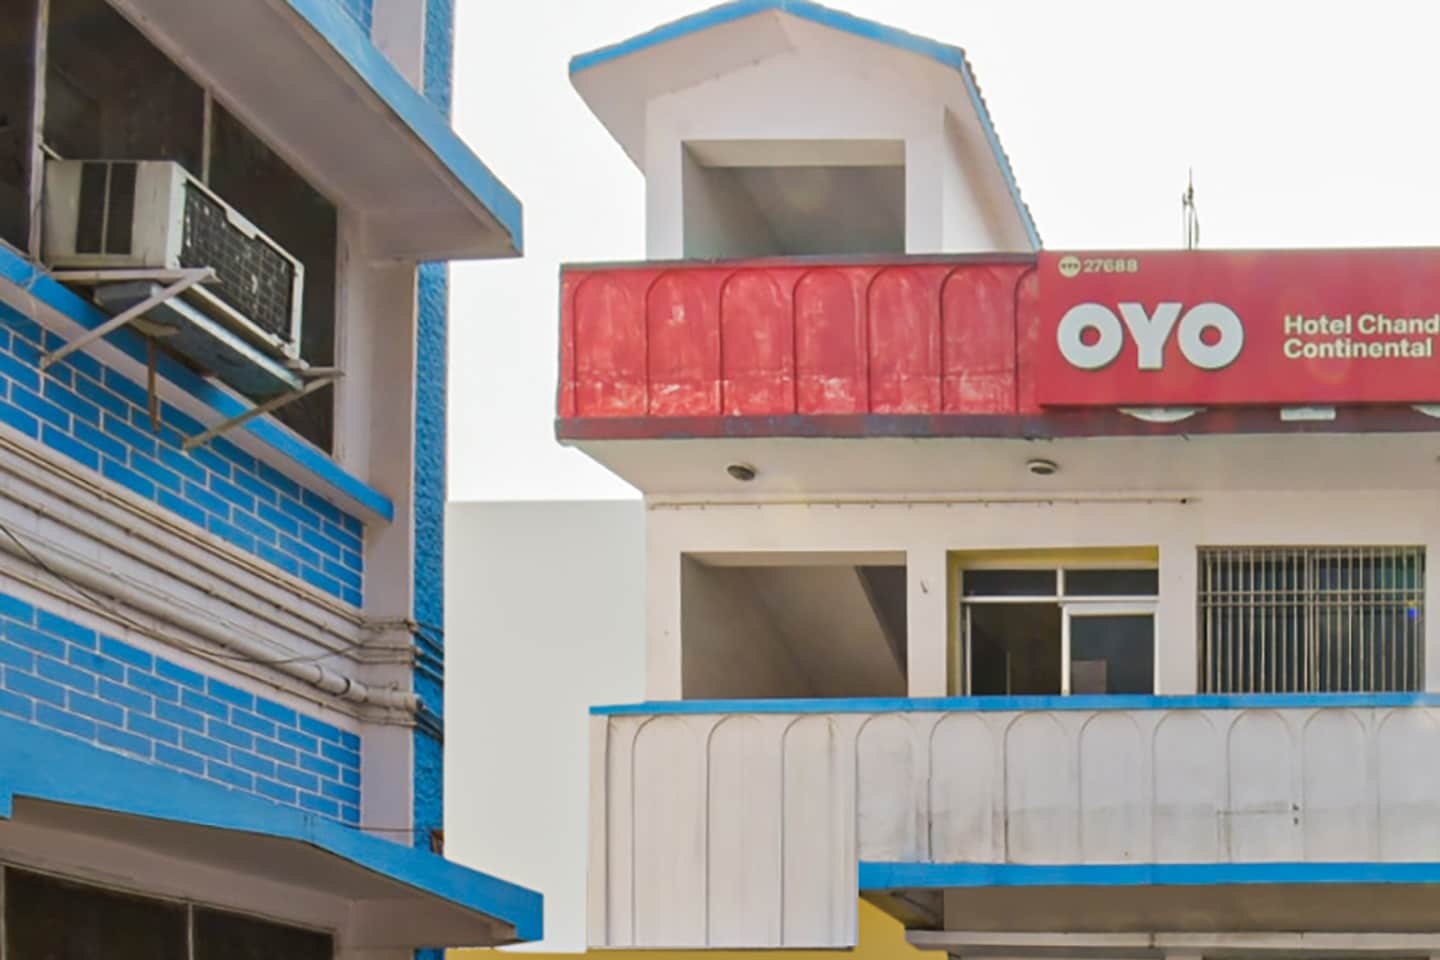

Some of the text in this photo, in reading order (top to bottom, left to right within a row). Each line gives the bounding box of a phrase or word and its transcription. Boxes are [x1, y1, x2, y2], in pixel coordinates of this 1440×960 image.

[1057, 302, 1244, 369] OYO
[1284, 314, 1352, 335] Hotel
[1283, 337, 1433, 359] Continental
